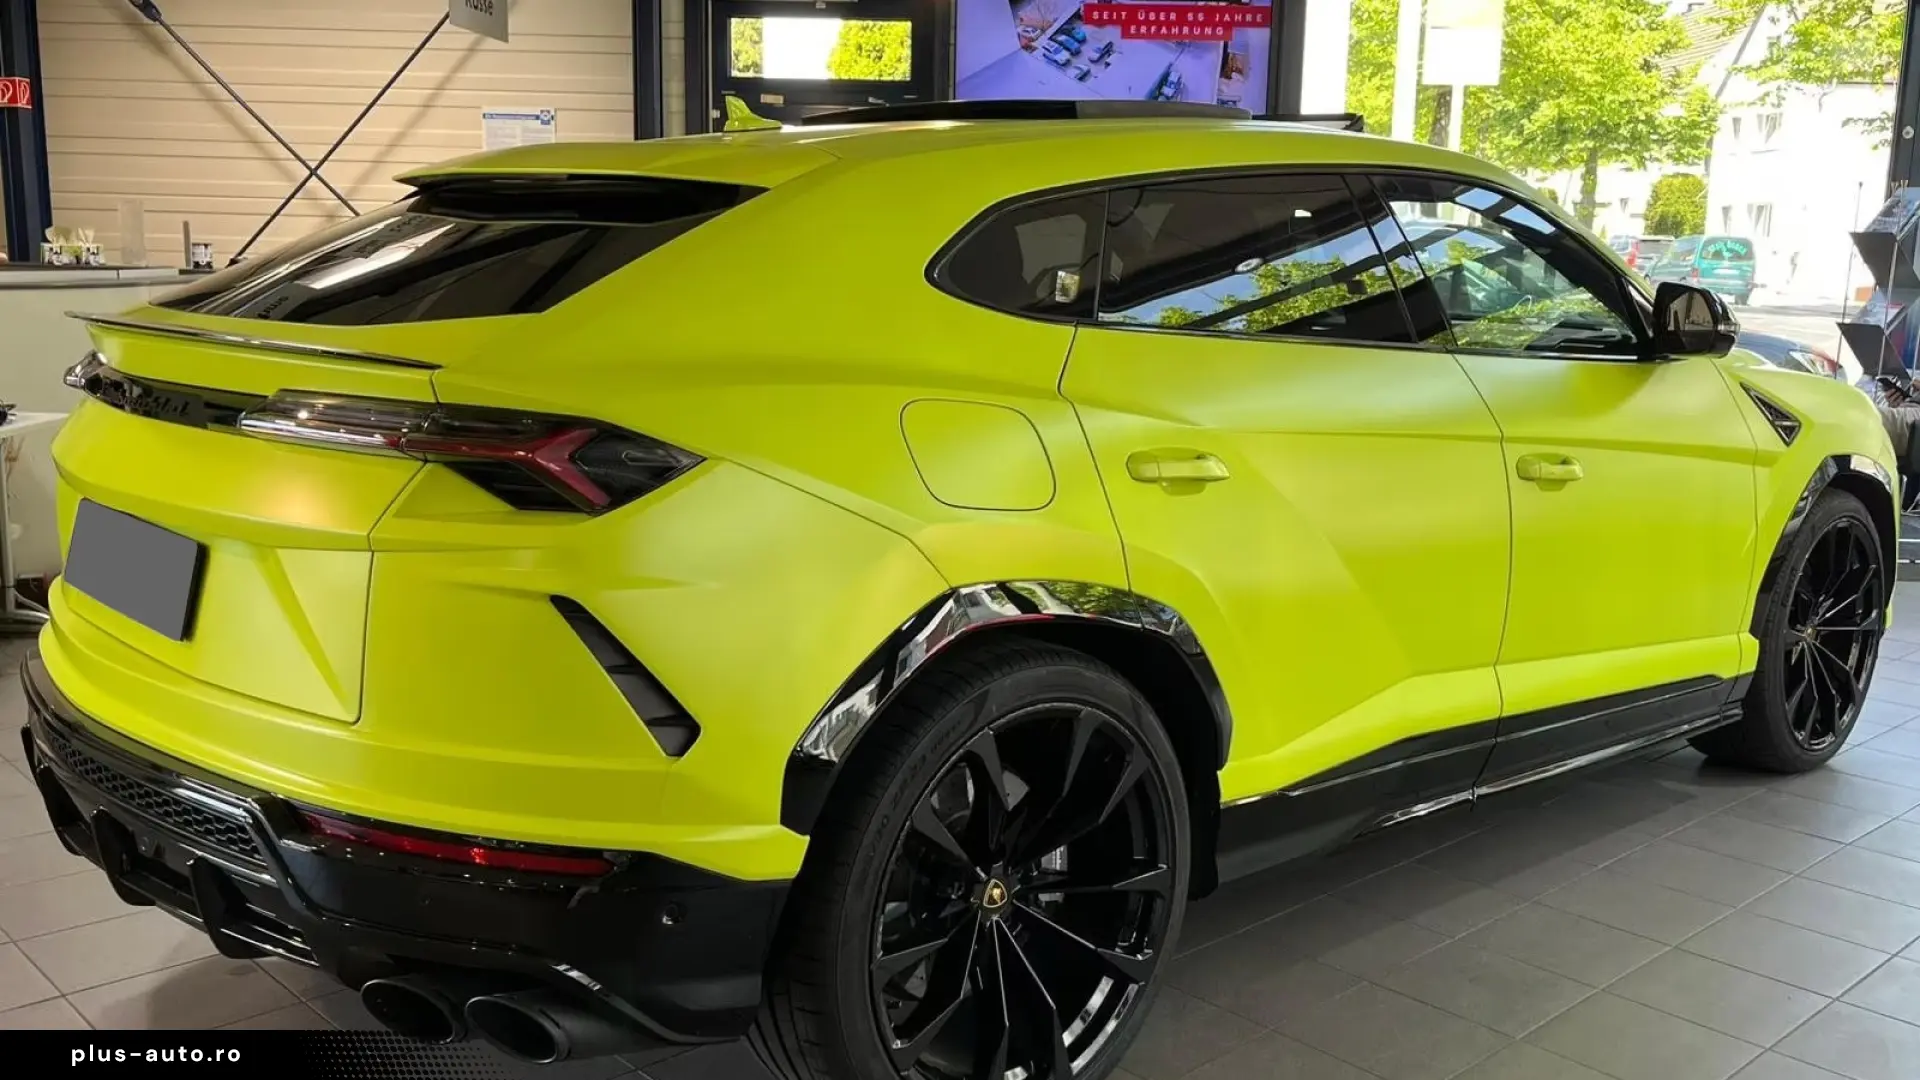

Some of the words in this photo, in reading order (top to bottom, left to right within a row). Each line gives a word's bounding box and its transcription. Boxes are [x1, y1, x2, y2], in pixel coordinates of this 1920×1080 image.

[1092, 11, 1128, 20] SEIT
[1137, 9, 1177, 21] ÜBER
[1215, 12, 1263, 23] JAHRE
[1130, 24, 1224, 35] ERFAHRUNG
